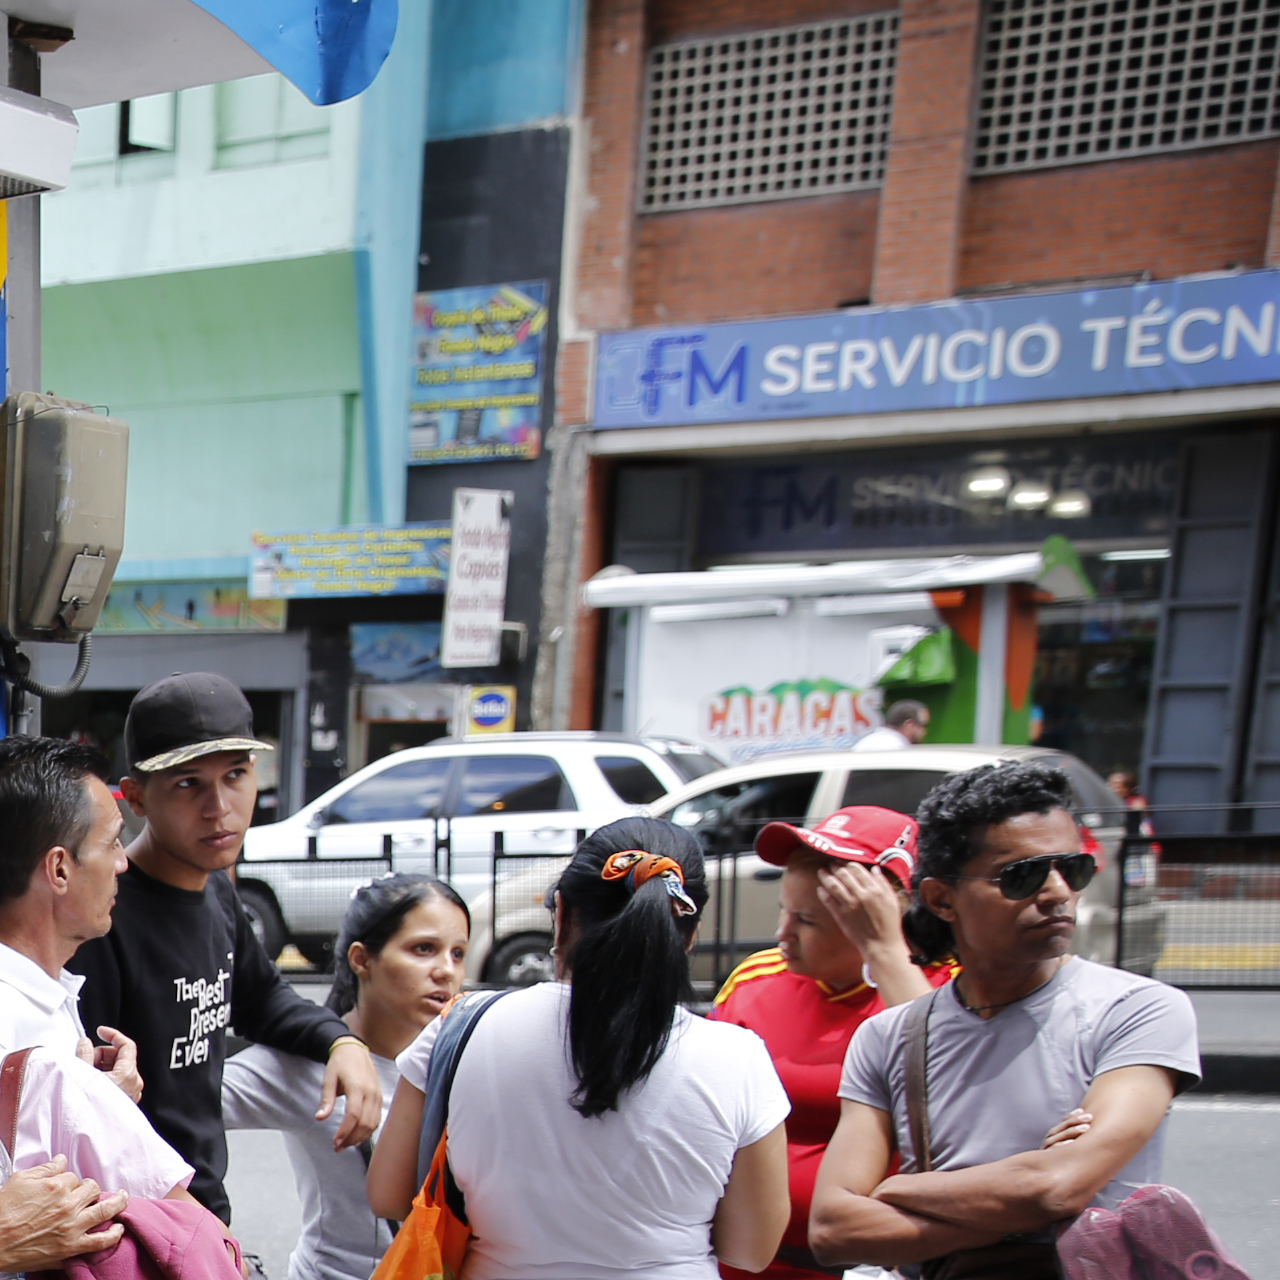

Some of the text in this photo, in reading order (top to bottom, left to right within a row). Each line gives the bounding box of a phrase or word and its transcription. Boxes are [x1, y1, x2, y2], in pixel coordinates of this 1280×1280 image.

[641, 297, 1280, 415] FM SERVICIO TÉCN
[703, 688, 885, 739] CARACAS
[197, 968, 231, 1012] Best
[188, 1000, 232, 1041] Presen
[170, 1033, 210, 1070] Ever
